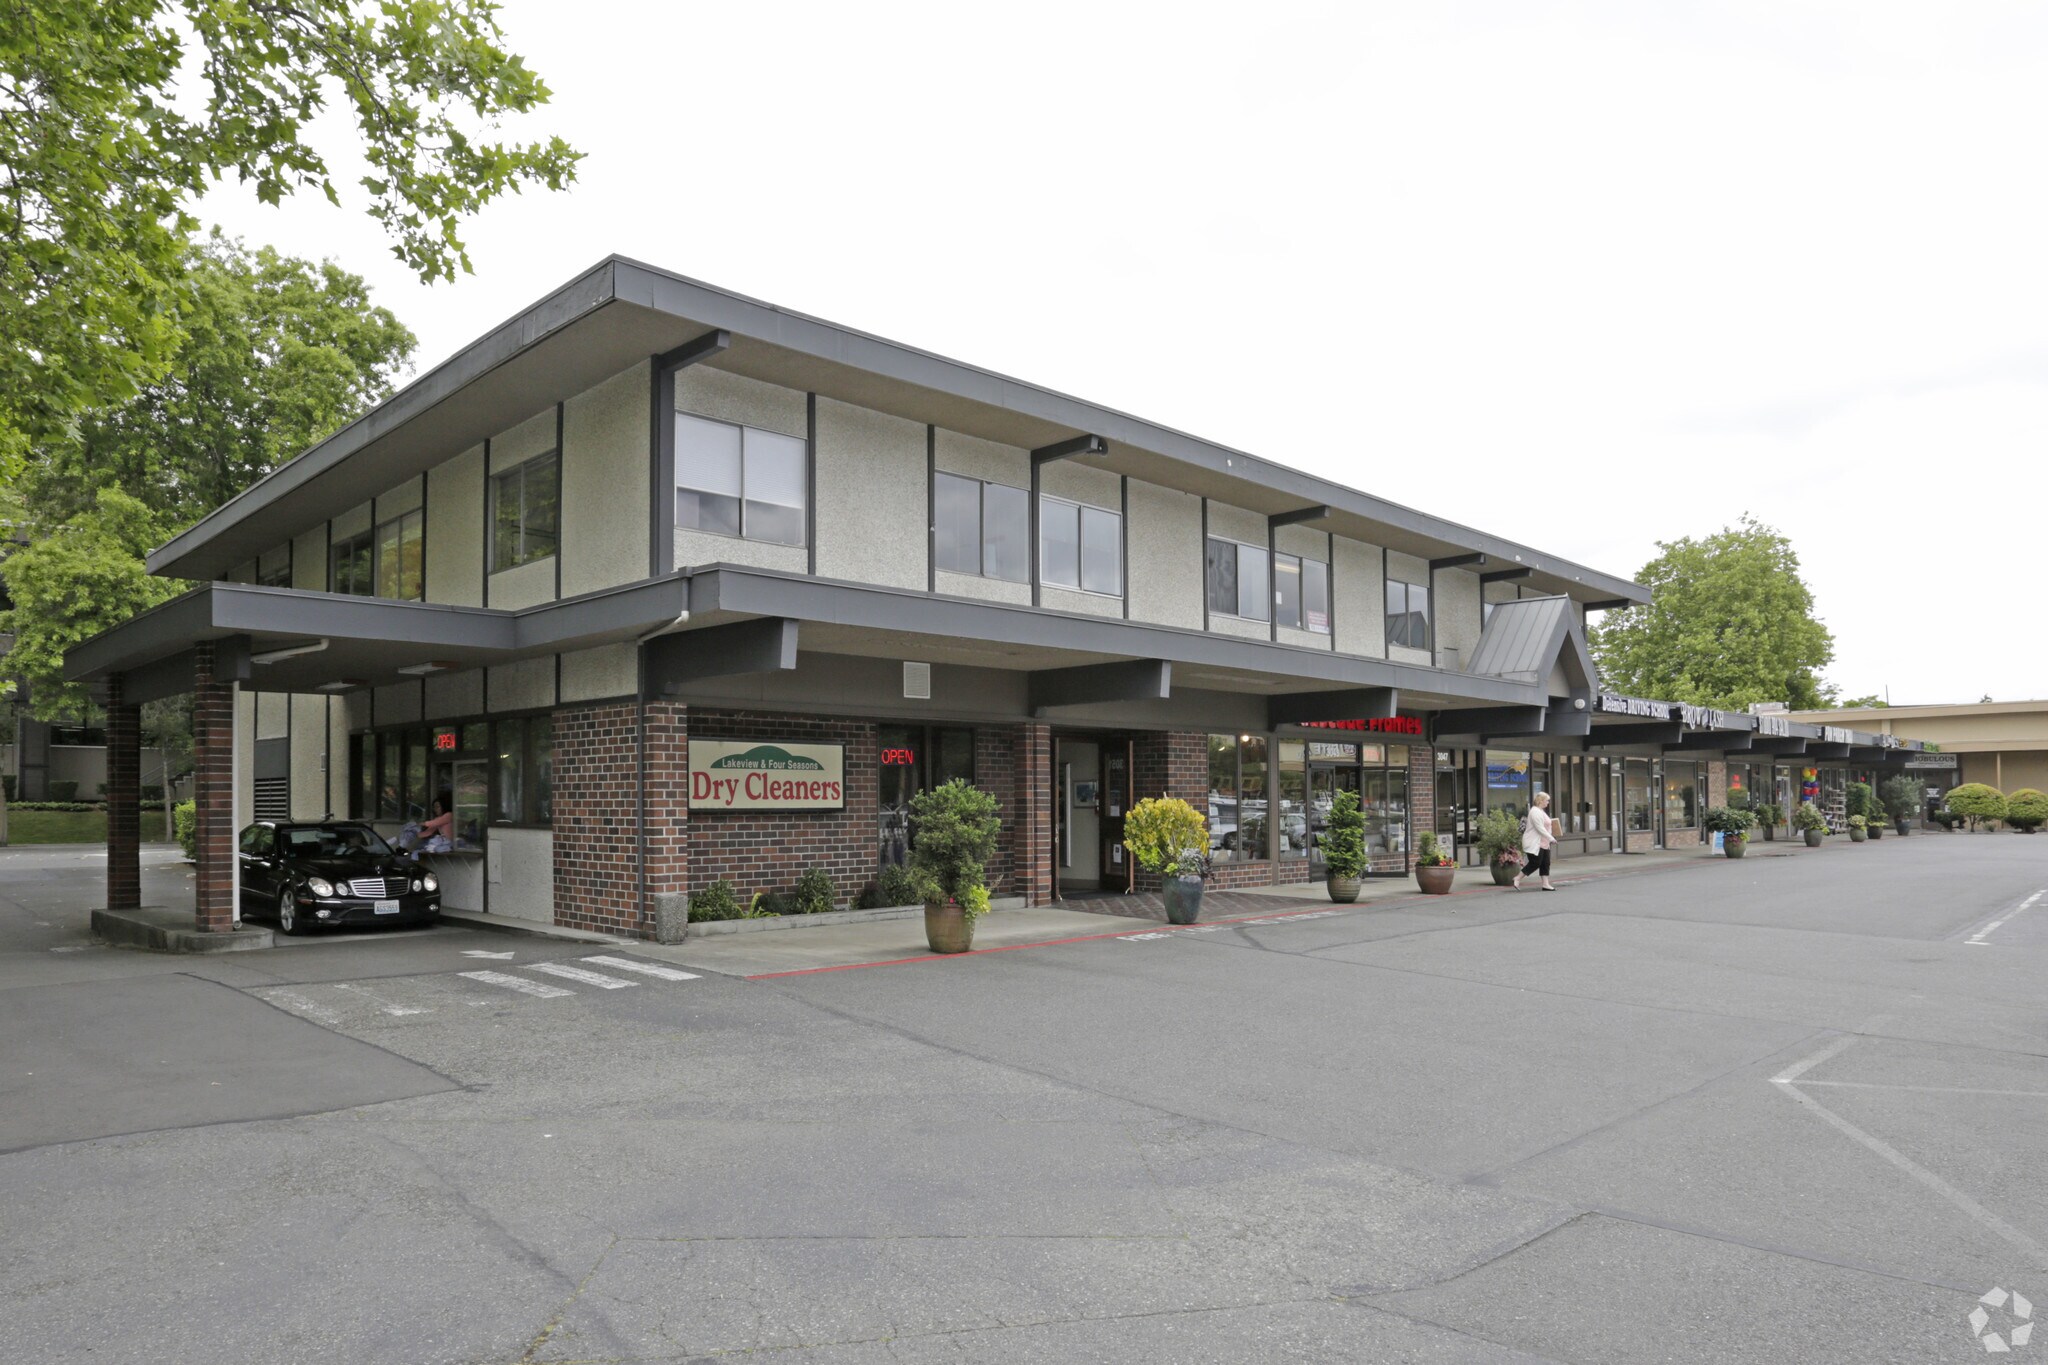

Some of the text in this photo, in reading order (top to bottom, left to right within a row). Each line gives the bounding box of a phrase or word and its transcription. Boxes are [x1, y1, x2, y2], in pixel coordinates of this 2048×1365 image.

[1627, 699, 1651, 716] DRIVING
[1651, 702, 1670, 719] SCHOOL
[1369, 715, 1423, 735] Frames
[722, 758, 818, 770] Lakeview & Four Seasons
[882, 749, 914, 765] OPEN
[1437, 752, 1449, 761] 3047
[692, 771, 841, 806] Dry Cleaners
